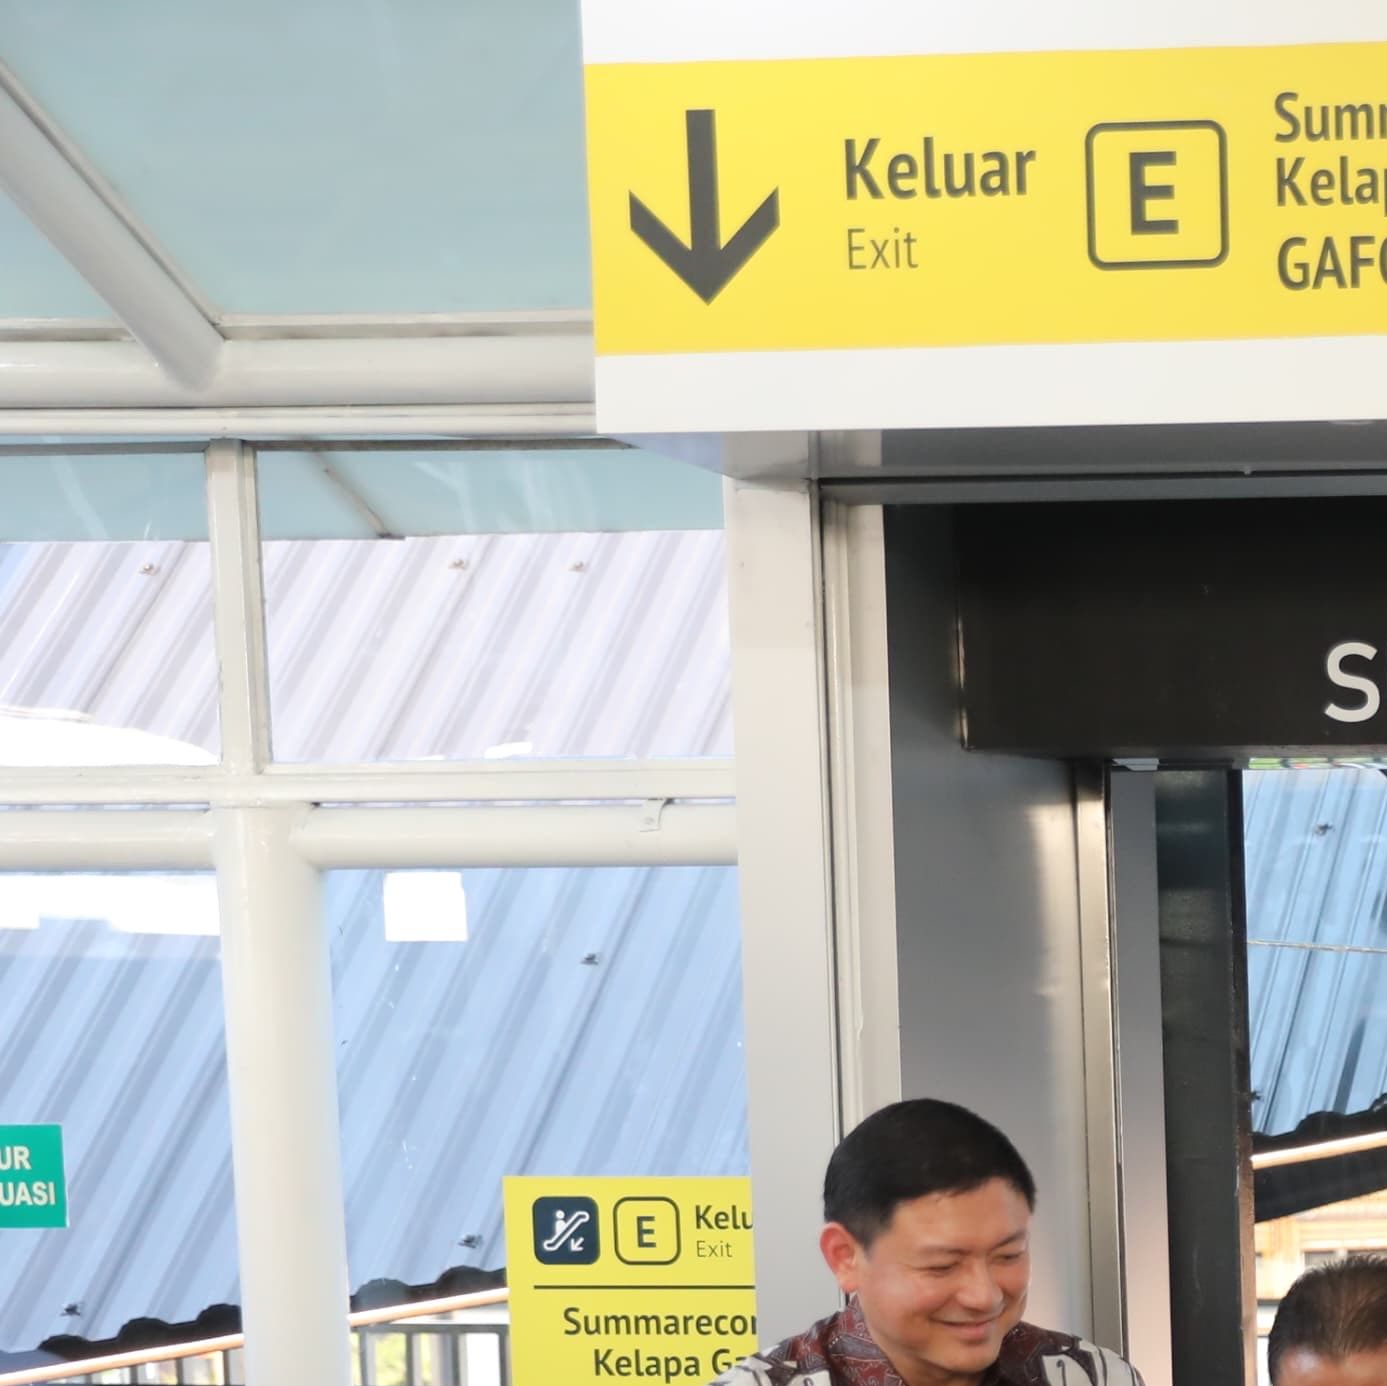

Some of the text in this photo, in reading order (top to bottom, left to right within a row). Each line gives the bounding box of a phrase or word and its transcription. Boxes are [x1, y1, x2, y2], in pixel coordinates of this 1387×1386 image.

[844, 136, 1036, 200] Keluar
[1128, 150, 1179, 235] E
[847, 227, 919, 270] Exit
[636, 1216, 657, 1248] E
[696, 1239, 733, 1258] Exit
[594, 1348, 700, 1384] Kelapa
